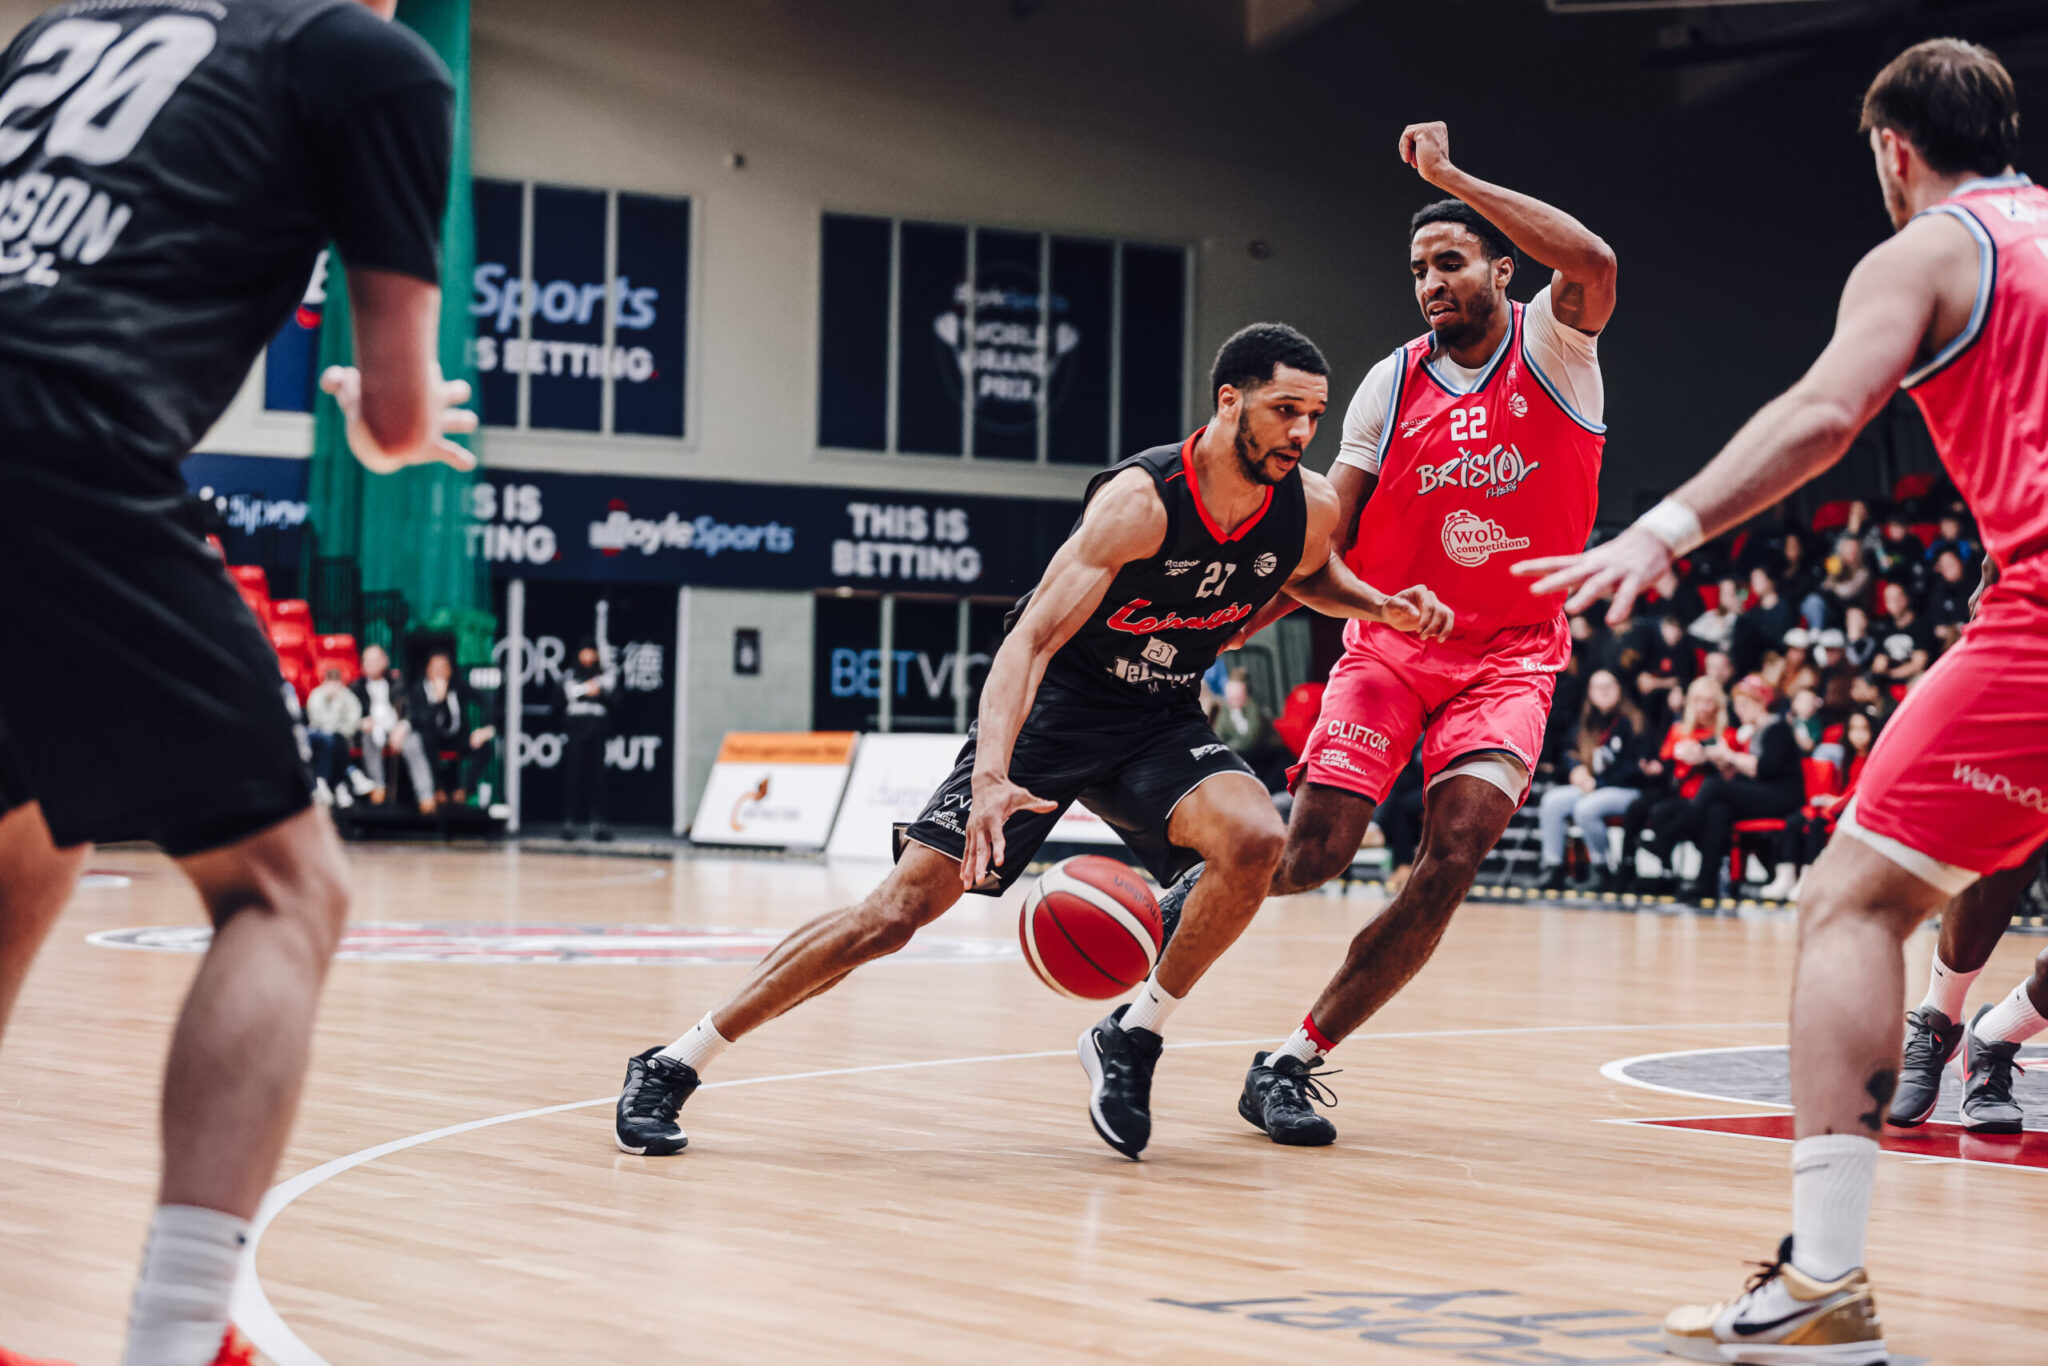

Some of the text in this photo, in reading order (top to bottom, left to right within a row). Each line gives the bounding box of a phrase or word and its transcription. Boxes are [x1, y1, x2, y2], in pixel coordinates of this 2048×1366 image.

[0, 14, 217, 167] 20
[468, 262, 659, 333] Sports
[1450, 406, 1487, 441] 22
[503, 484, 543, 524] IS
[847, 503, 969, 543] THIS IS
[1453, 521, 1504, 545] wob
[1456, 538, 1529, 555] competitions
[1321, 748, 1348, 757] SUPER
[1327, 719, 1391, 753] CLIFTON
[1320, 754, 1351, 765] LEAGUE
[1320, 759, 1368, 776] BASKETBALL
